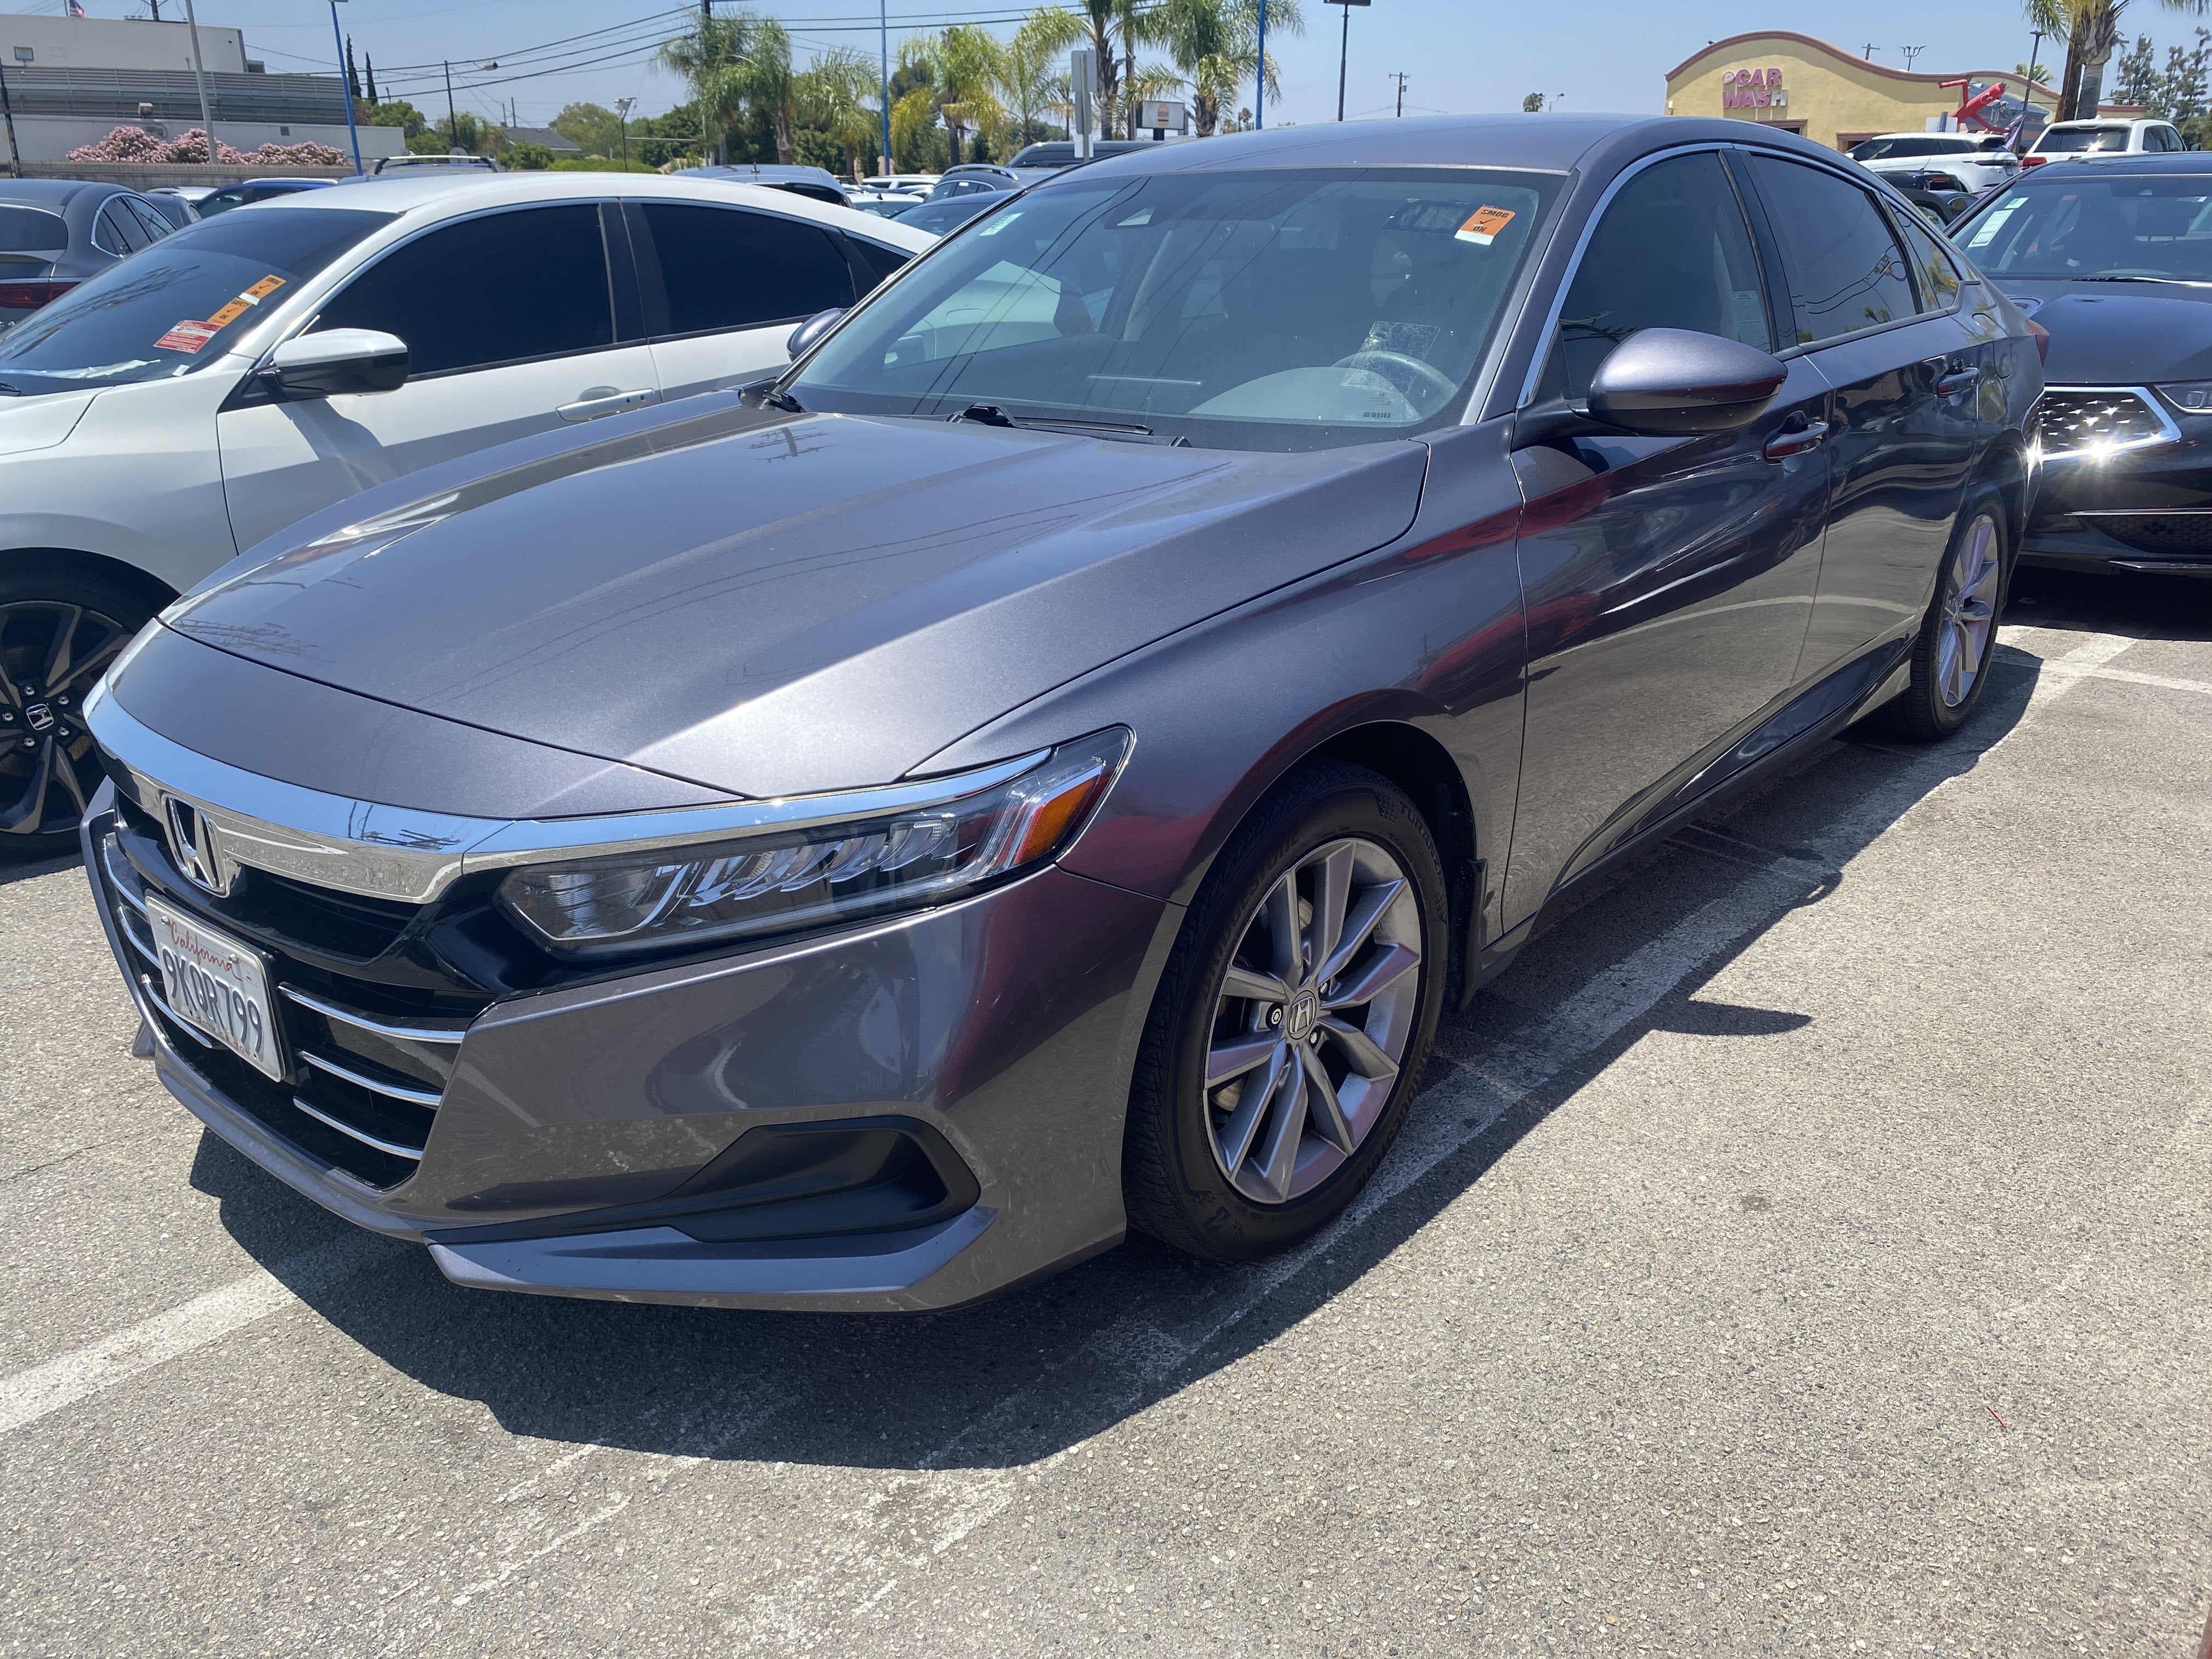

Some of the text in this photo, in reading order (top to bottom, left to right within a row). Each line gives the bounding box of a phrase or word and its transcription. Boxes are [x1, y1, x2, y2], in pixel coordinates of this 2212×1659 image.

[1735, 68, 1782, 87] CAR
[1723, 89, 1787, 108] WASH
[1481, 209, 1509, 218] SMOG
[1397, 798, 1443, 889] TURANZA
[169, 921, 242, 981] California
[162, 946, 262, 1054] 9KQR799
[196, 1016, 251, 1056] dmv.ca.gov
